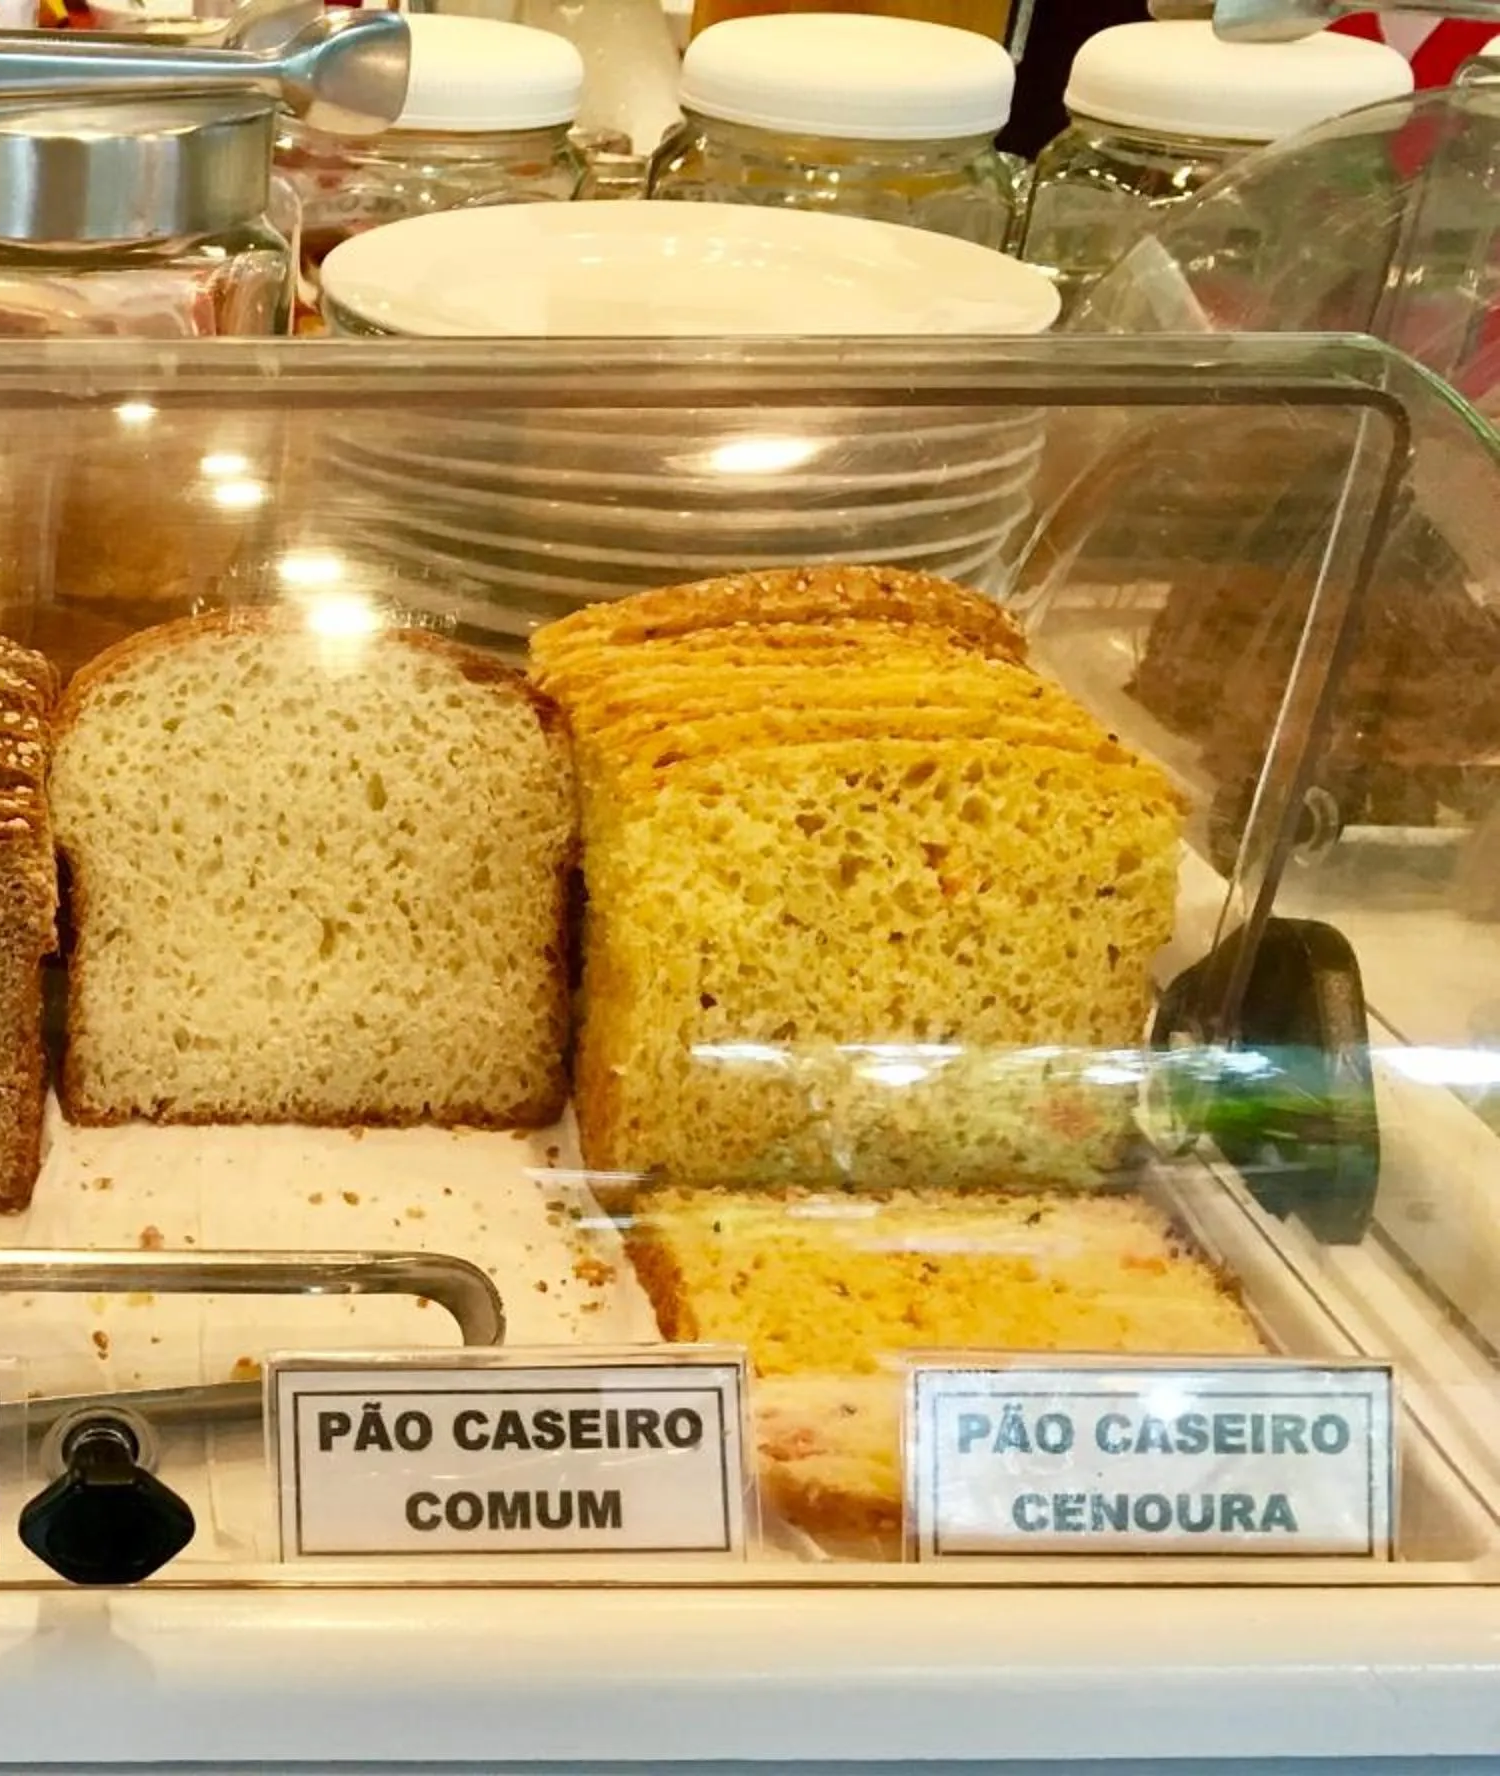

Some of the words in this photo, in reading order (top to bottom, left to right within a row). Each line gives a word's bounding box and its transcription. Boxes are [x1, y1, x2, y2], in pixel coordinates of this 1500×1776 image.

[318, 1402, 433, 1452] PÃO
[453, 1408, 704, 1451] CASEIRO
[957, 1403, 1075, 1455] PÃO
[1095, 1413, 1350, 1455] CASEIRO
[405, 1490, 622, 1531] COMUM
[1012, 1493, 1299, 1533] CENOURA
